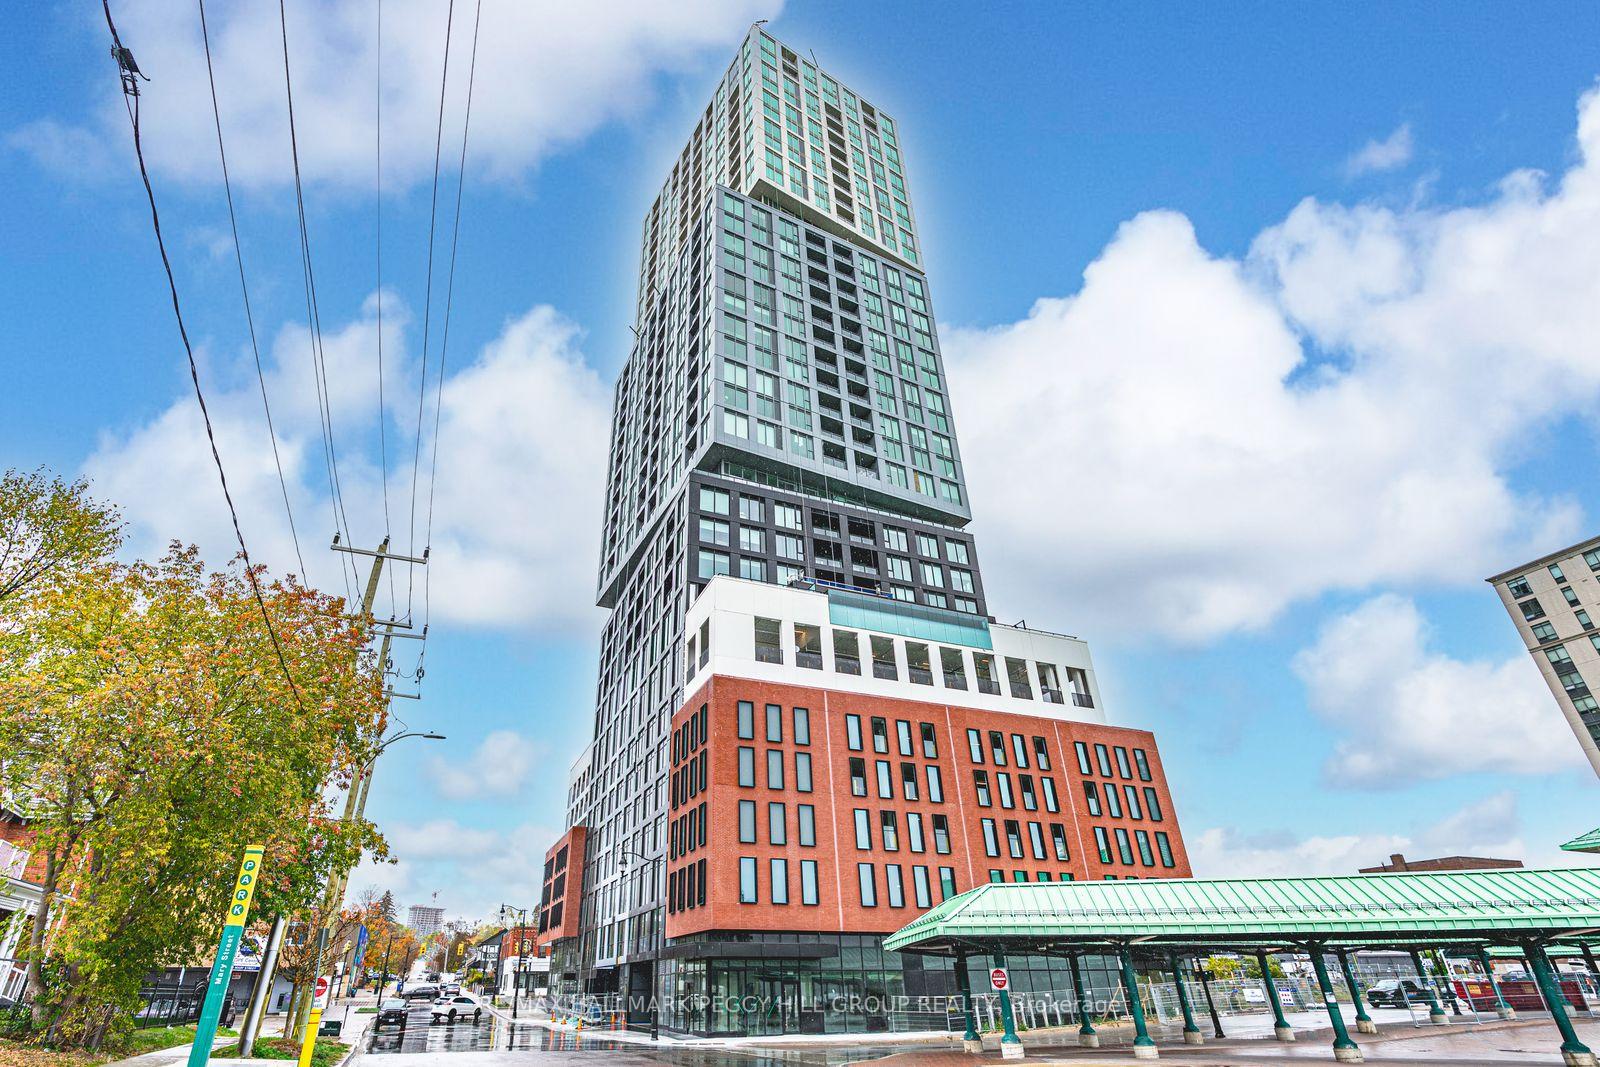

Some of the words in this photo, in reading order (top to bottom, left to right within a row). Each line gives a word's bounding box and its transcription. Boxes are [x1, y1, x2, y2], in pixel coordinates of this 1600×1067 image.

[233, 861, 254, 915] PARK
[221, 934, 234, 961] Street
[215, 964, 228, 985] Mary
